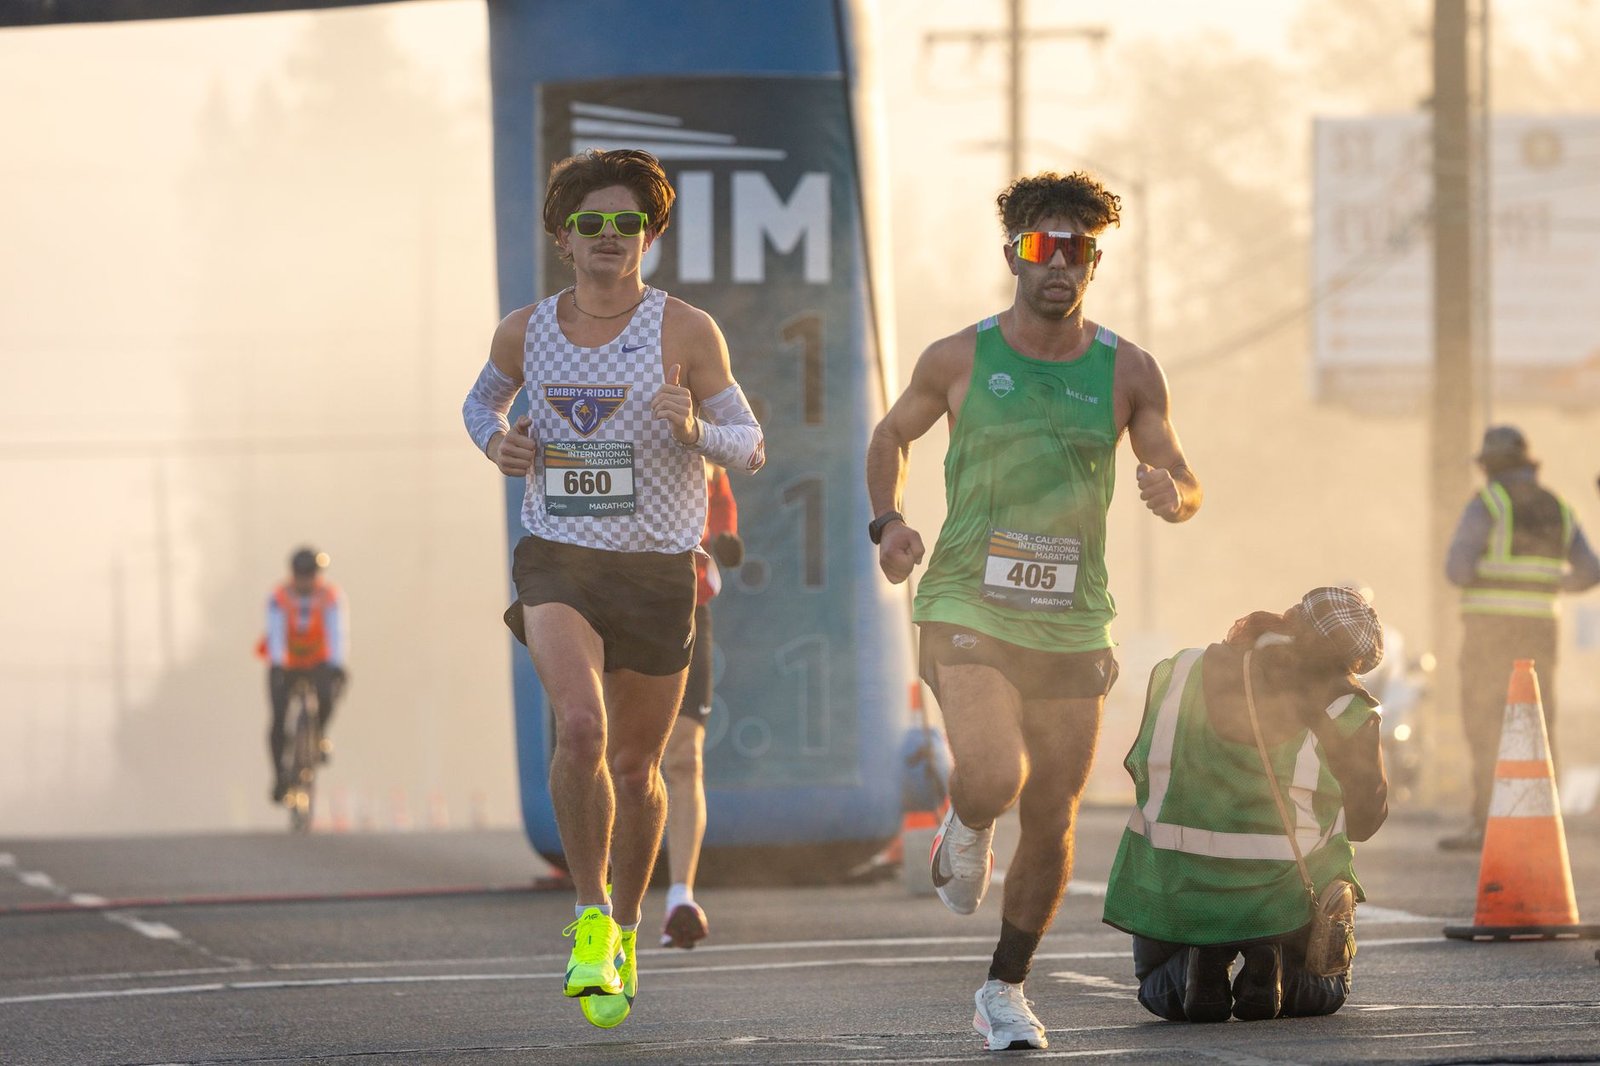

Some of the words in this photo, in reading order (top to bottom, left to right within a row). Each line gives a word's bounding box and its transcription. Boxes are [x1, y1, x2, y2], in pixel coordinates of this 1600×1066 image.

[640, 170, 832, 284] IM
[547, 387, 624, 398] EMBRY-RIDDLE
[556, 442, 577, 451] 2024
[567, 450, 632, 458] INTERNATIONAL
[585, 458, 632, 466] MARATHON
[563, 470, 611, 495] 660
[589, 501, 635, 511] MARATHON
[1006, 531, 1029, 542] 2024
[1017, 541, 1080, 554] INTERNATIONAL
[1035, 551, 1080, 562] MARATHON
[1006, 562, 1057, 590] 405
[1030, 596, 1073, 606] MARATHON
